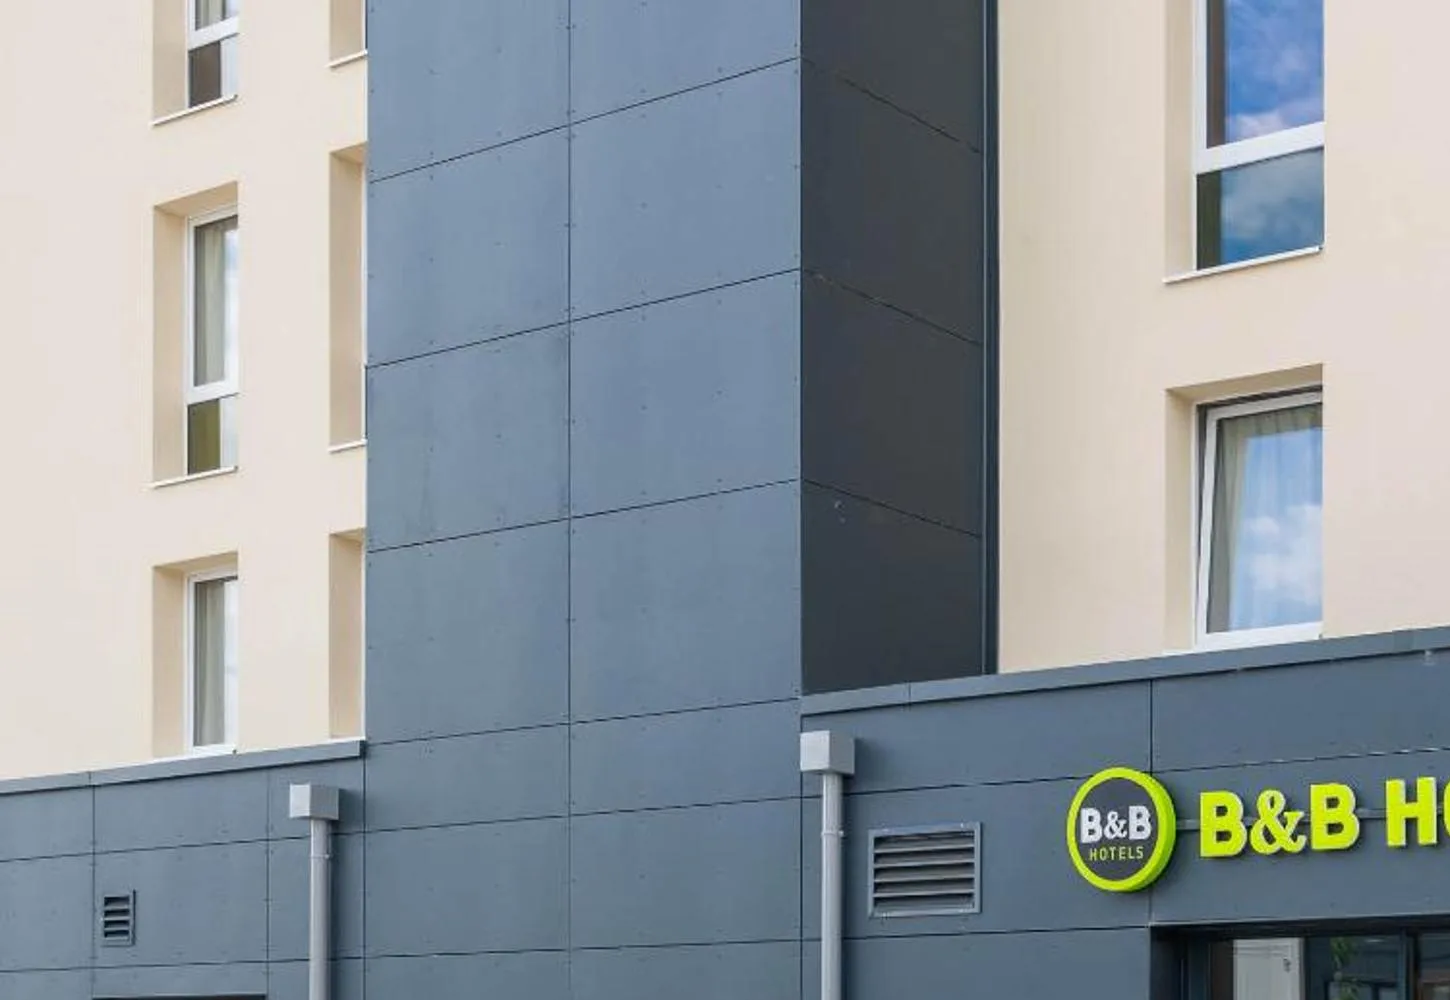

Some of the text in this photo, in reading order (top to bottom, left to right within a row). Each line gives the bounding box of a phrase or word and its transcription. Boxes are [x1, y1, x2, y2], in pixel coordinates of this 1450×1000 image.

[1080, 805, 1152, 843] B&B
[1200, 783, 1360, 857] B&B
[1089, 846, 1144, 861] HOTELS
